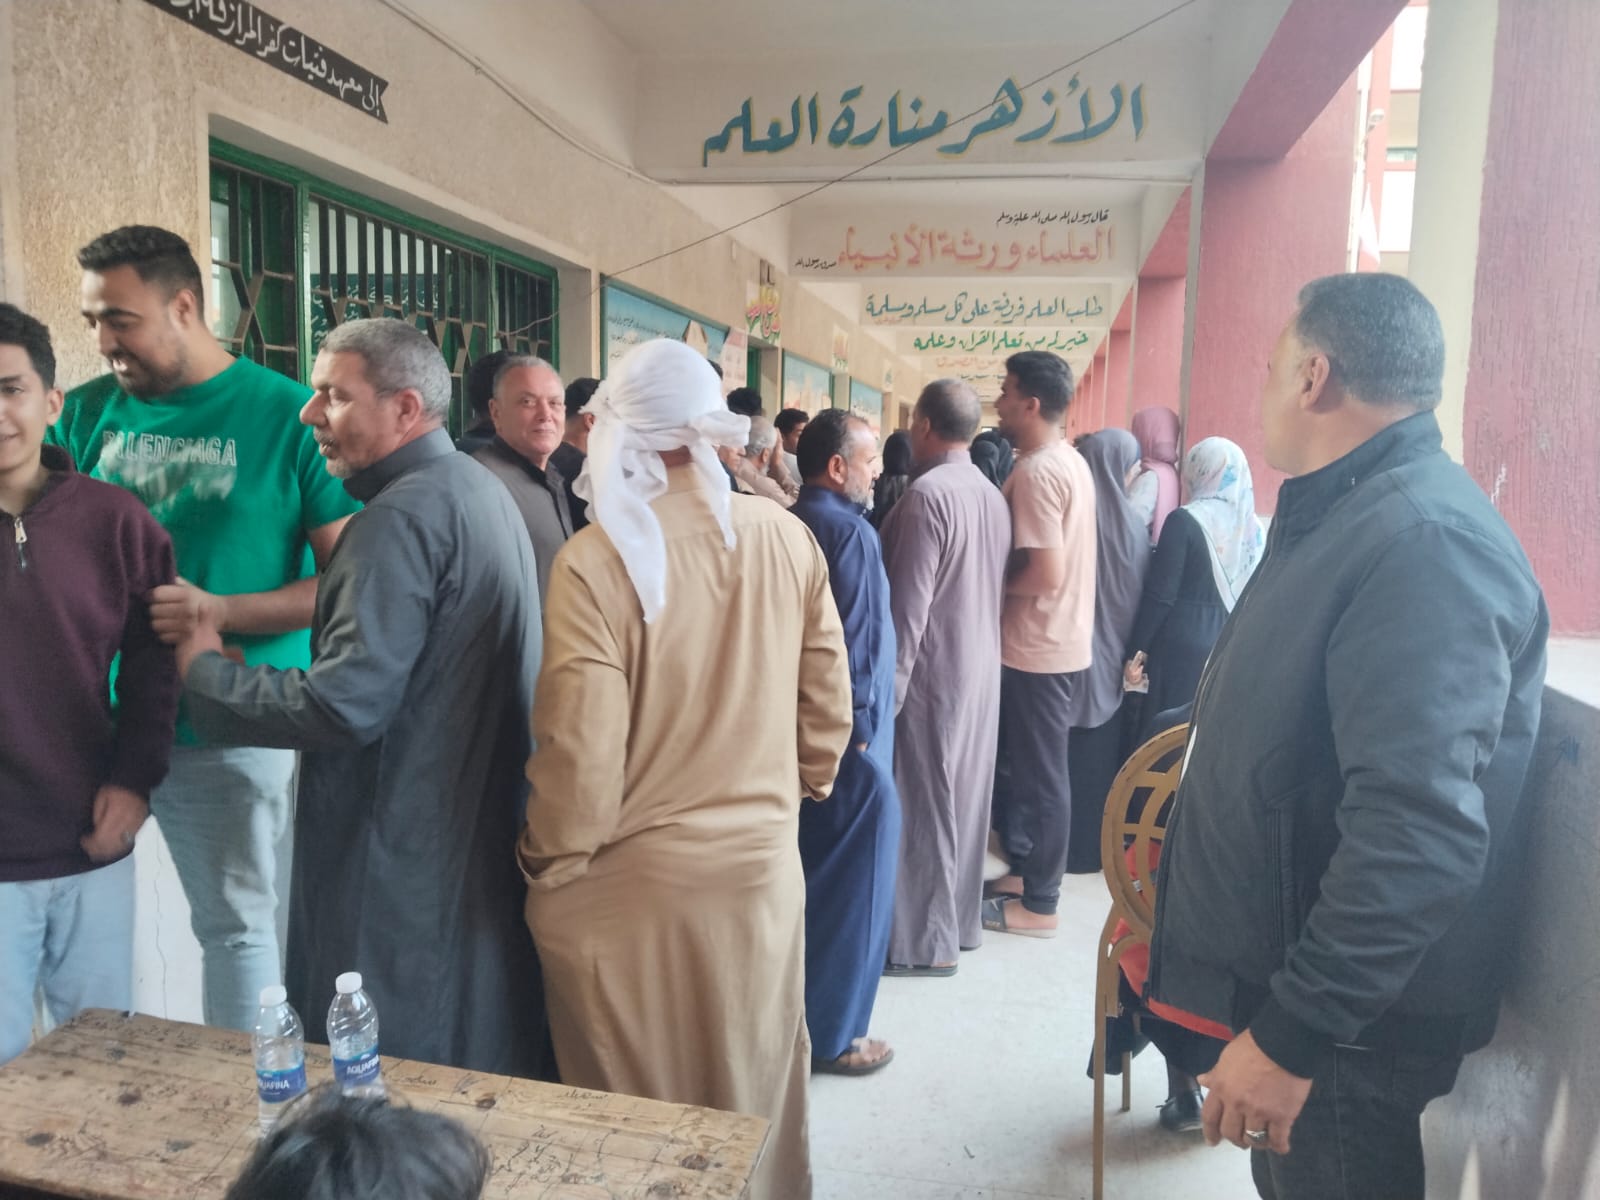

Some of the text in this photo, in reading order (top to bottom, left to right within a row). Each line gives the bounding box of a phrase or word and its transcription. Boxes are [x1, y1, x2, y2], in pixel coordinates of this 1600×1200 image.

[256, 23, 290, 57] كفر
[282, 34, 327, 80] فتيات
[326, 67, 363, 99] معهد
[362, 78, 380, 117] إلى
[702, 70, 1145, 168] الأزهر منارة العلم
[1041, 212, 1058, 225] صلى
[1070, 210, 1093, 225] رسول
[1091, 208, 1110, 225] قال
[838, 223, 1114, 273] العلماء ورثة الأنبياء
[912, 296, 946, 325] مسلم
[944, 291, 968, 321] كل
[962, 297, 991, 324] على
[1023, 296, 1065, 327] العلم
[1066, 295, 1103, 323] طلب
[913, 331, 956, 350] وعلمه
[992, 331, 1025, 354] تعلم
